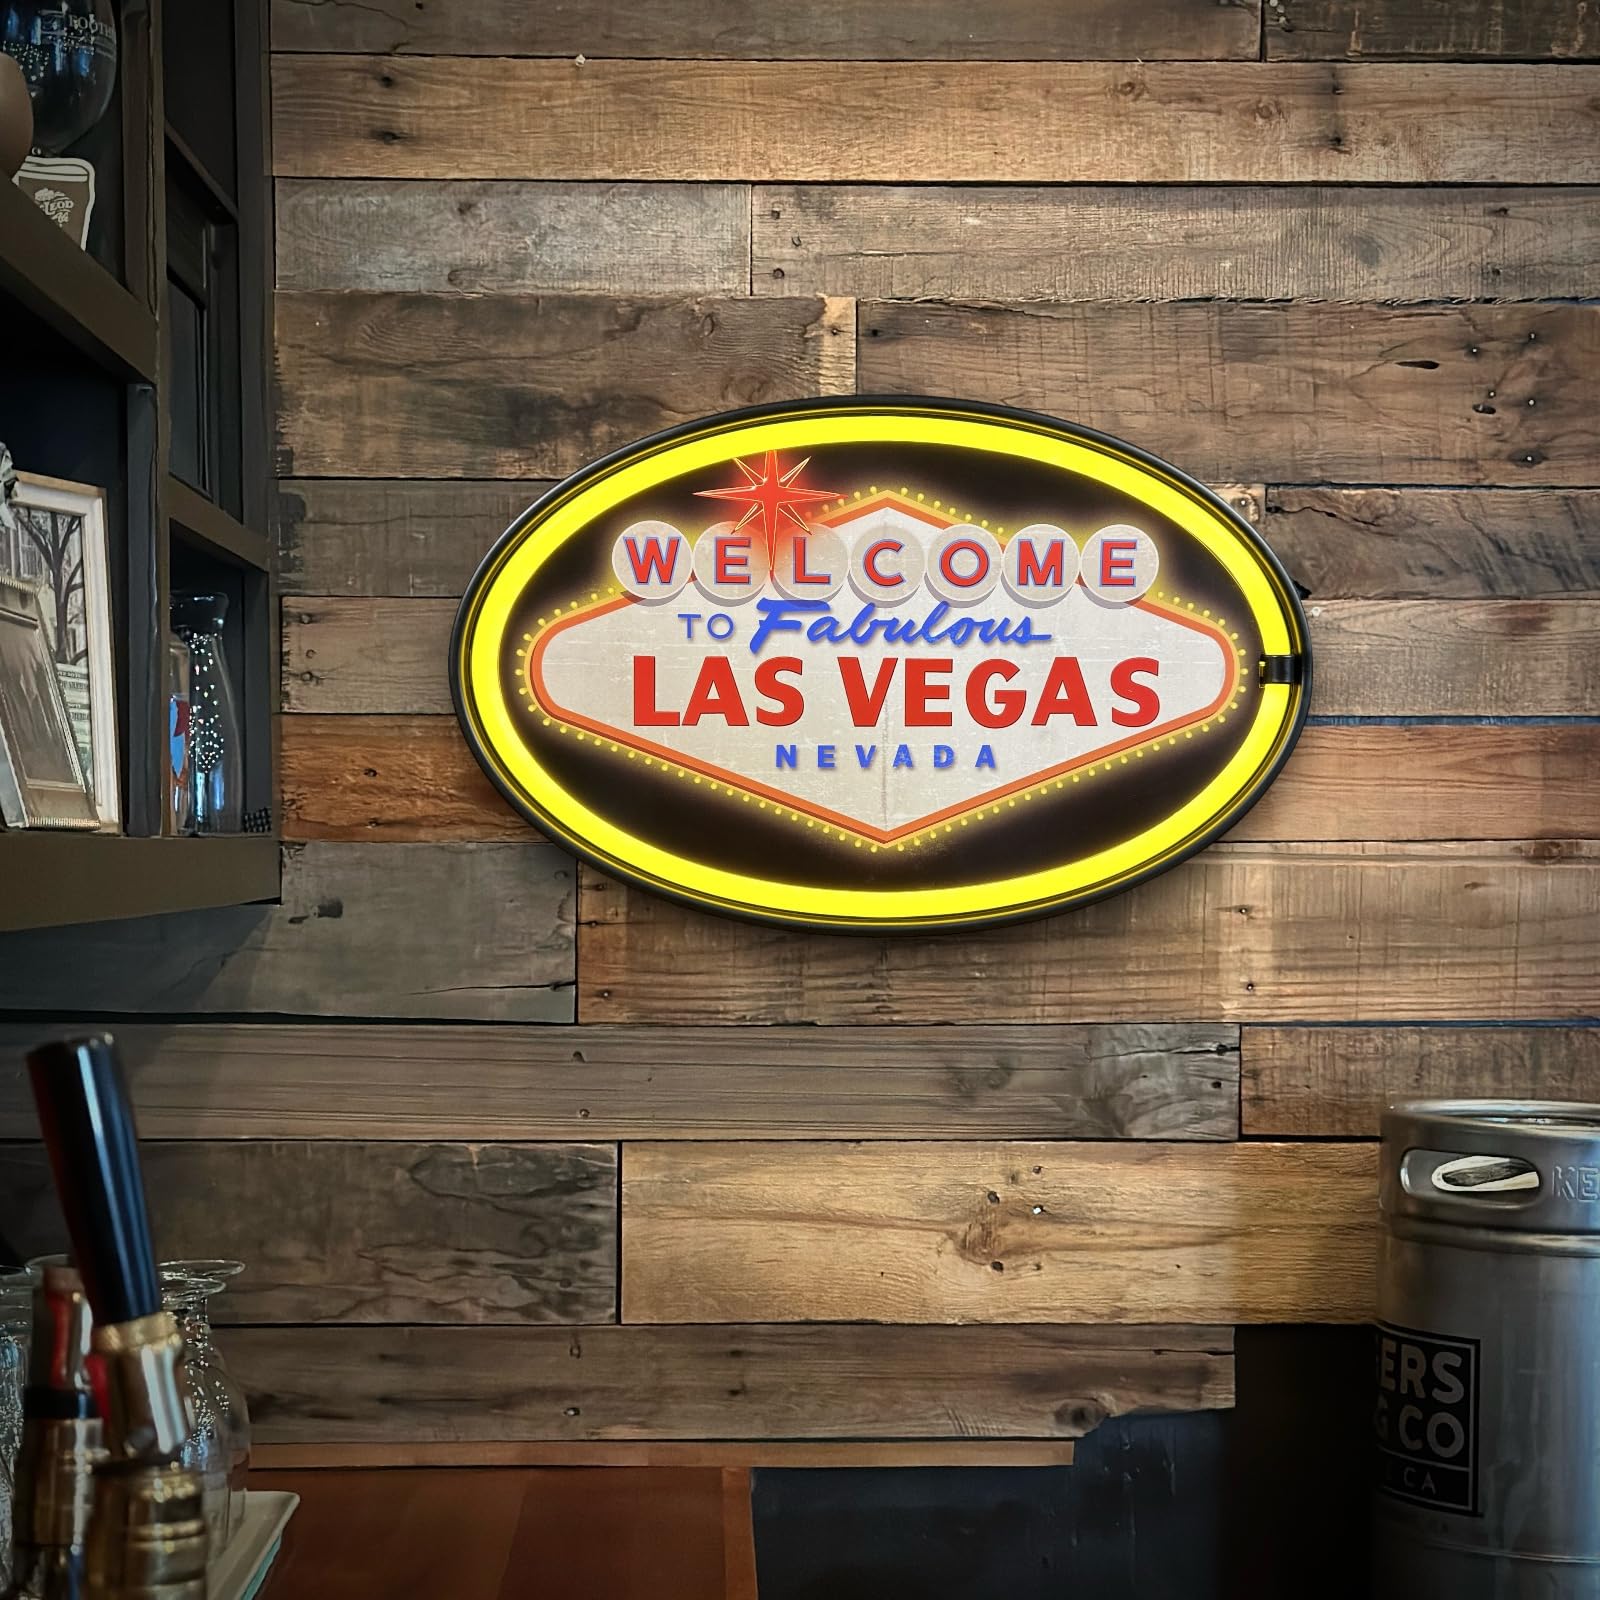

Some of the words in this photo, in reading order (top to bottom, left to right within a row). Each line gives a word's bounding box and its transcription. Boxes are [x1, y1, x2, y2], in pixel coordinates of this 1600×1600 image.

[623, 535, 1138, 589] WELCOME
[677, 612, 735, 640] TO
[749, 597, 1052, 654] Fabulous
[633, 655, 805, 728] LAS
[836, 655, 1161, 730] VEGAS
[776, 744, 997, 769] NEVADA
